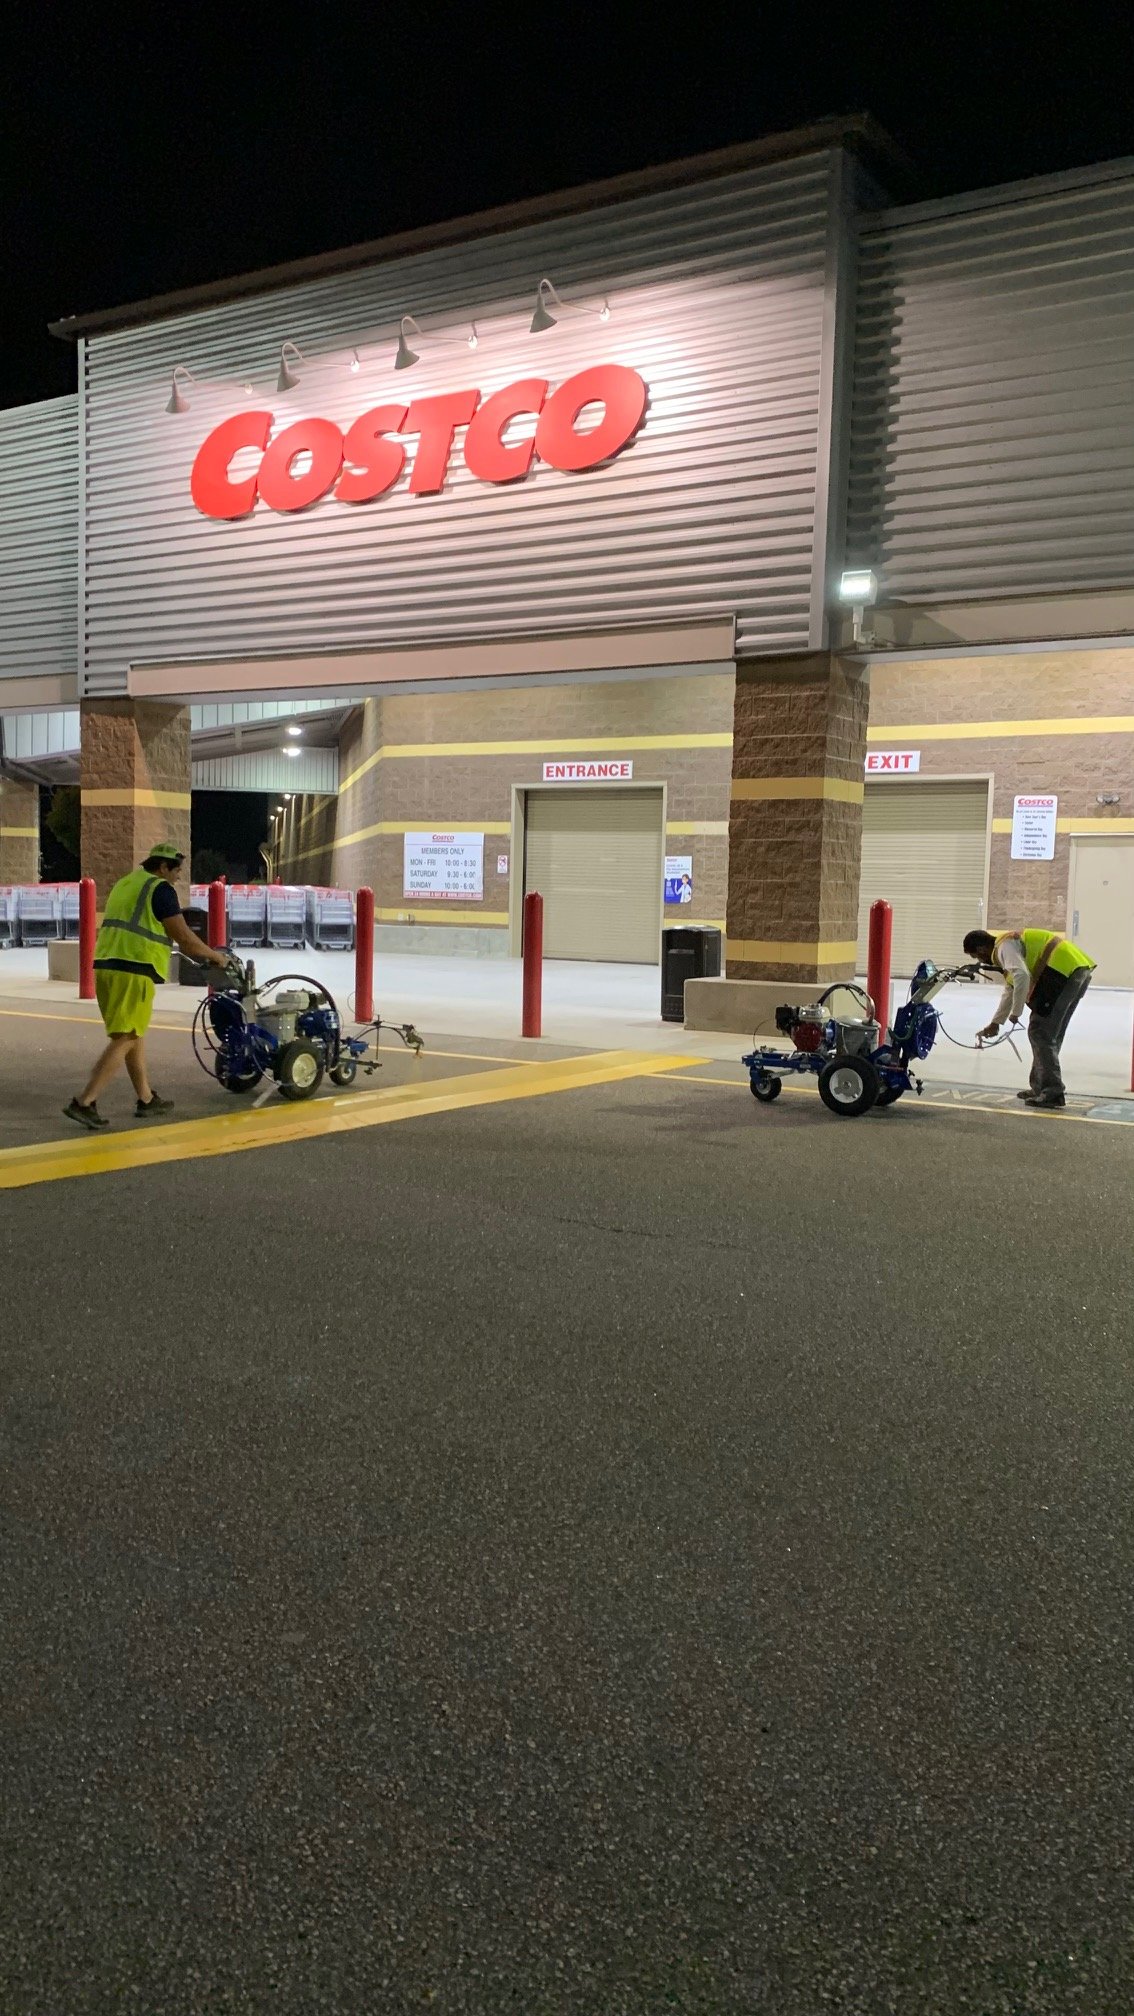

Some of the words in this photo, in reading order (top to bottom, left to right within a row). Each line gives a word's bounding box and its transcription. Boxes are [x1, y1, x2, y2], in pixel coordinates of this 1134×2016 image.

[190, 363, 646, 520] COSTCO
[867, 754, 913, 770] EXIT
[546, 763, 630, 778] ENTRANCE
[1018, 798, 1054, 806] COSTCO
[421, 847, 449, 855] MEMBERS
[449, 847, 465, 855] ONLY
[409, 881, 431, 889] SUNDAY
